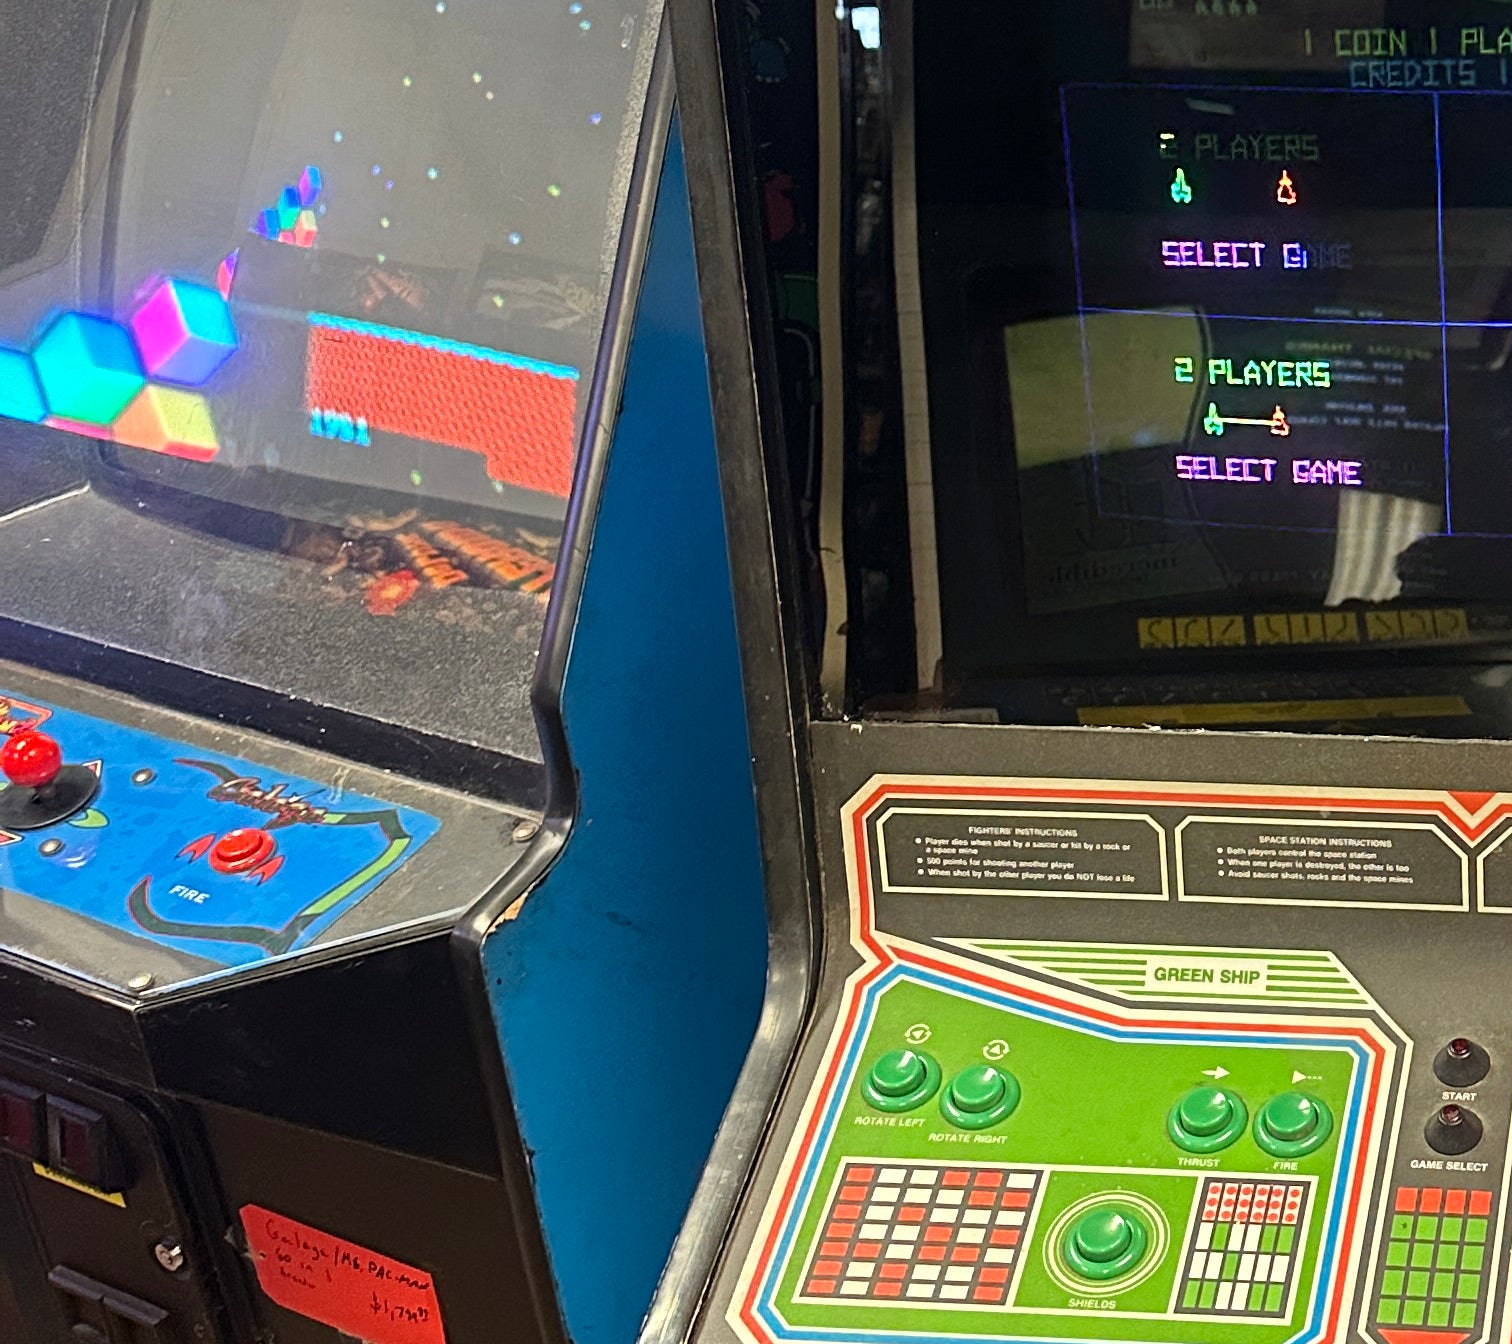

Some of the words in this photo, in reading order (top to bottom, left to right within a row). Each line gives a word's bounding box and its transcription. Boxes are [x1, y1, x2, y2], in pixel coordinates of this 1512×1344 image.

[1334, 29, 1406, 56] COIN
[1351, 58, 1476, 88] CREDITS
[1195, 134, 1320, 161] PLAYERS
[1162, 241, 1265, 267] SELECT
[1174, 357, 1193, 382] 2
[1208, 359, 1331, 387] PLAYERS
[1175, 456, 1278, 482] SELECT
[1292, 460, 1362, 485] GAME
[1015, 827, 1078, 837] INSTRUCTIONS
[1259, 836, 1288, 844] SPACE
[1289, 836, 1327, 845] STATION
[1329, 838, 1392, 848] INSTRUCTIONS
[1076, 873, 1094, 881] NOT
[168, 885, 210, 904] FIRE
[1153, 966, 1215, 984] GREEN
[1219, 968, 1261, 986] SHIP
[1442, 1091, 1477, 1101] START
[855, 1116, 896, 1127] ROTATE
[898, 1118, 926, 1128] LEFT
[928, 1133, 971, 1143] ROTATE
[973, 1134, 1009, 1145] RIGHT
[1178, 1157, 1221, 1168] THRUST
[1273, 1160, 1299, 1171] FIRE
[1410, 1159, 1443, 1170] GAME
[1446, 1161, 1489, 1172] SELECT
[1067, 1298, 1117, 1310] SHIELDS
